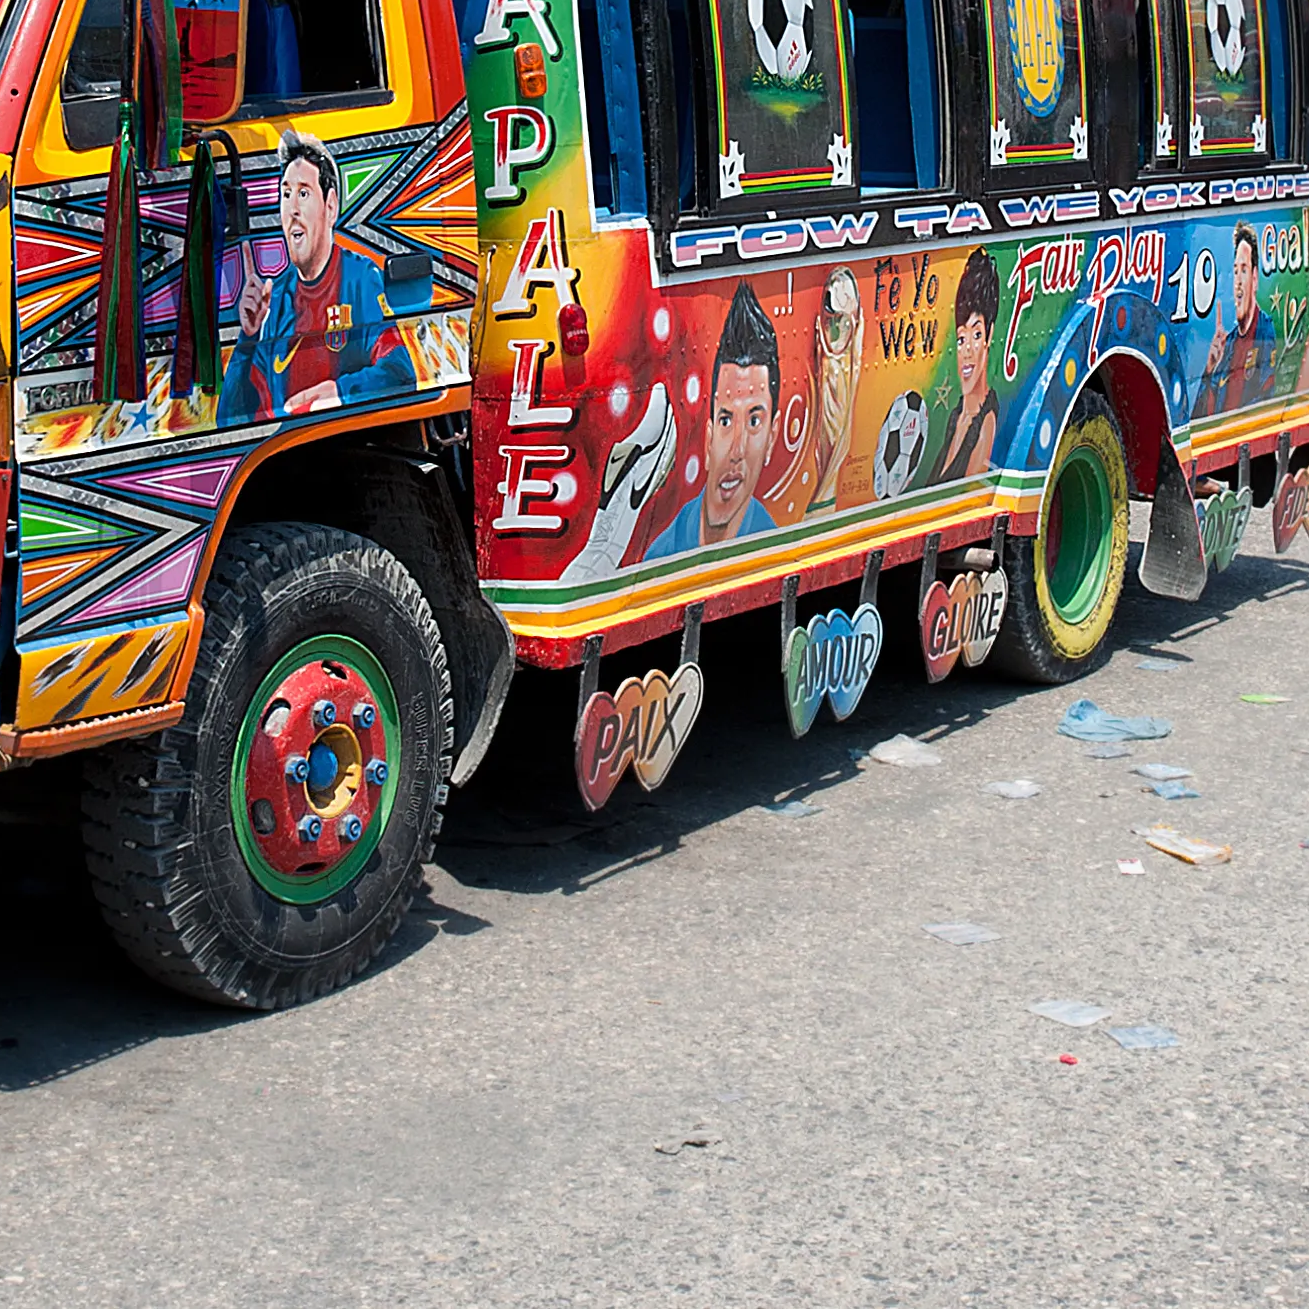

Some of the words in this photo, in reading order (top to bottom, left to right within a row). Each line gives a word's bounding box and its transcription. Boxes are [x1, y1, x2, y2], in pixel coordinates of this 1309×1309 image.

[894, 201, 992, 237] TA
[1109, 182, 1206, 214] YOK
[1004, 232, 1085, 381] Fair
[1169, 248, 1217, 323] 10
[27, 380, 94, 413] FORW
[1199, 505, 1247, 557] ONTE
[928, 591, 1003, 660] GLOIRE
[793, 632, 875, 706] AMOUR
[589, 692, 686, 784] PAIX
